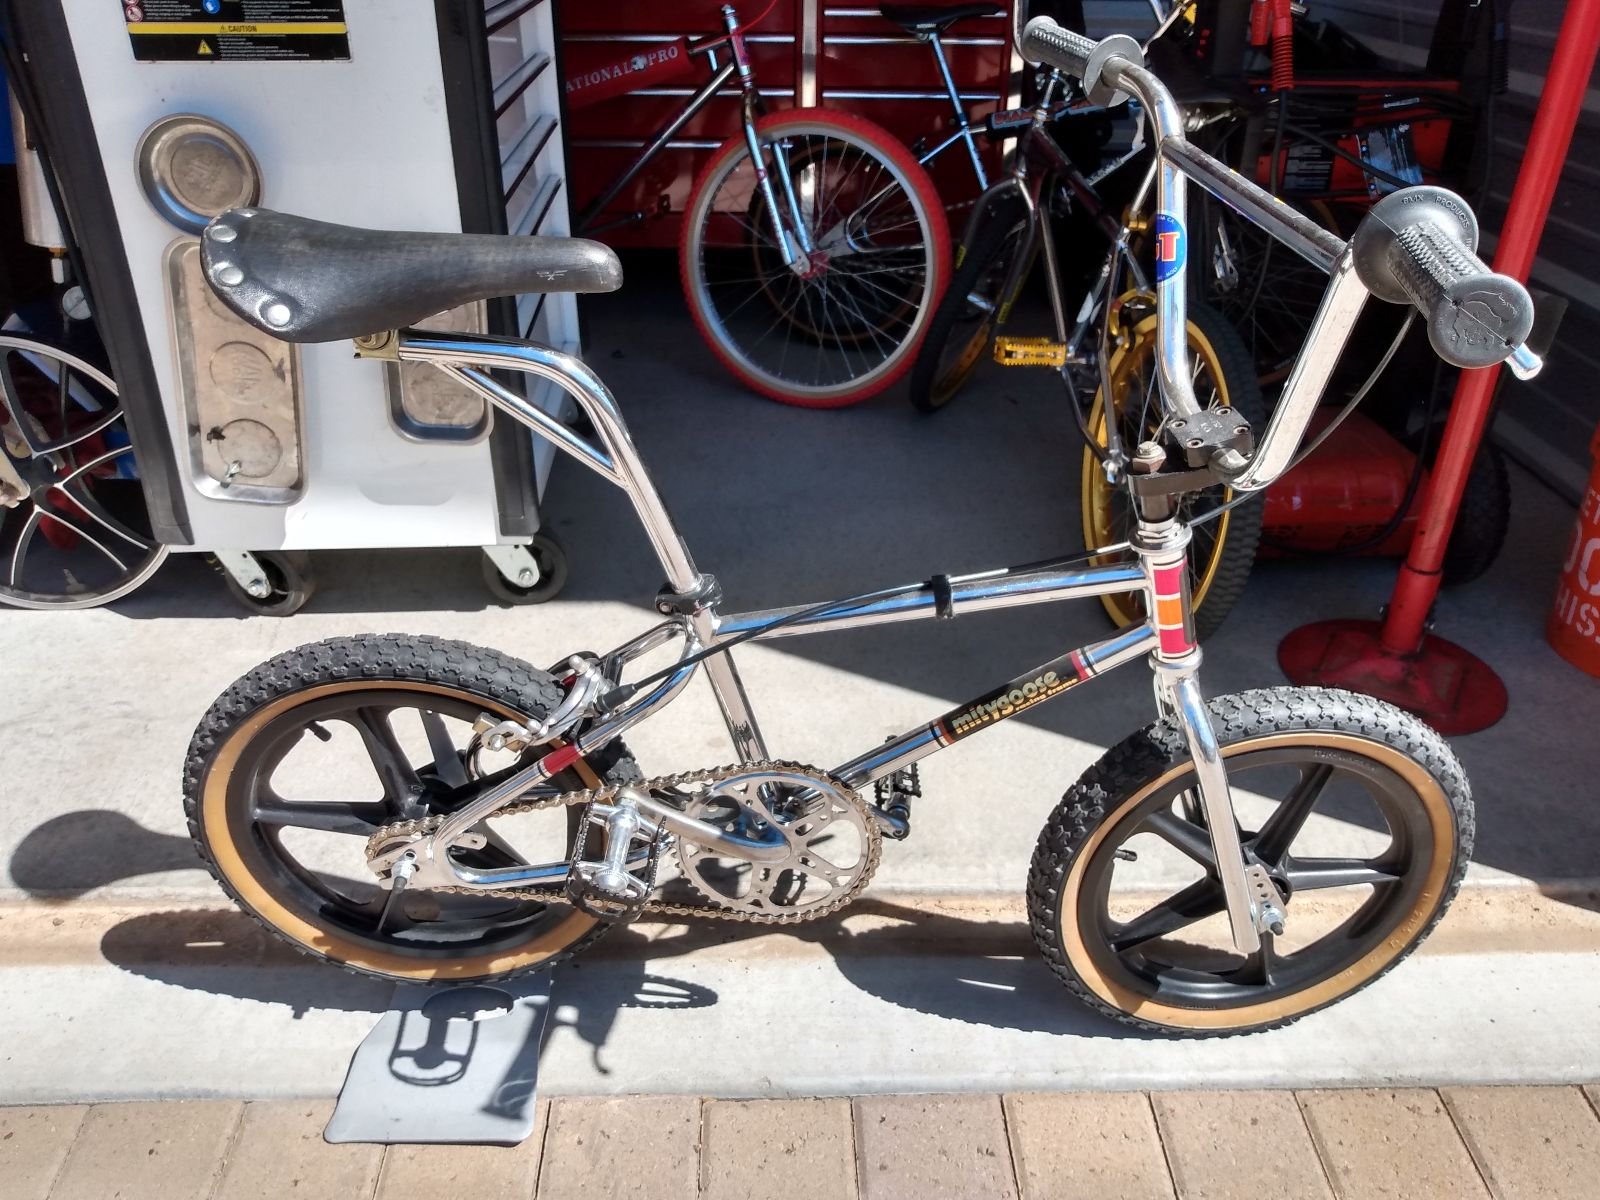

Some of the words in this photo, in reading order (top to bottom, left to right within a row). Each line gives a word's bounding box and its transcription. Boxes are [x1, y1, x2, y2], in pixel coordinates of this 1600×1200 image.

[647, 46, 679, 66] PRO
[1435, 195, 1470, 229] PRODUCTS
[951, 670, 1061, 735] mitygoose
